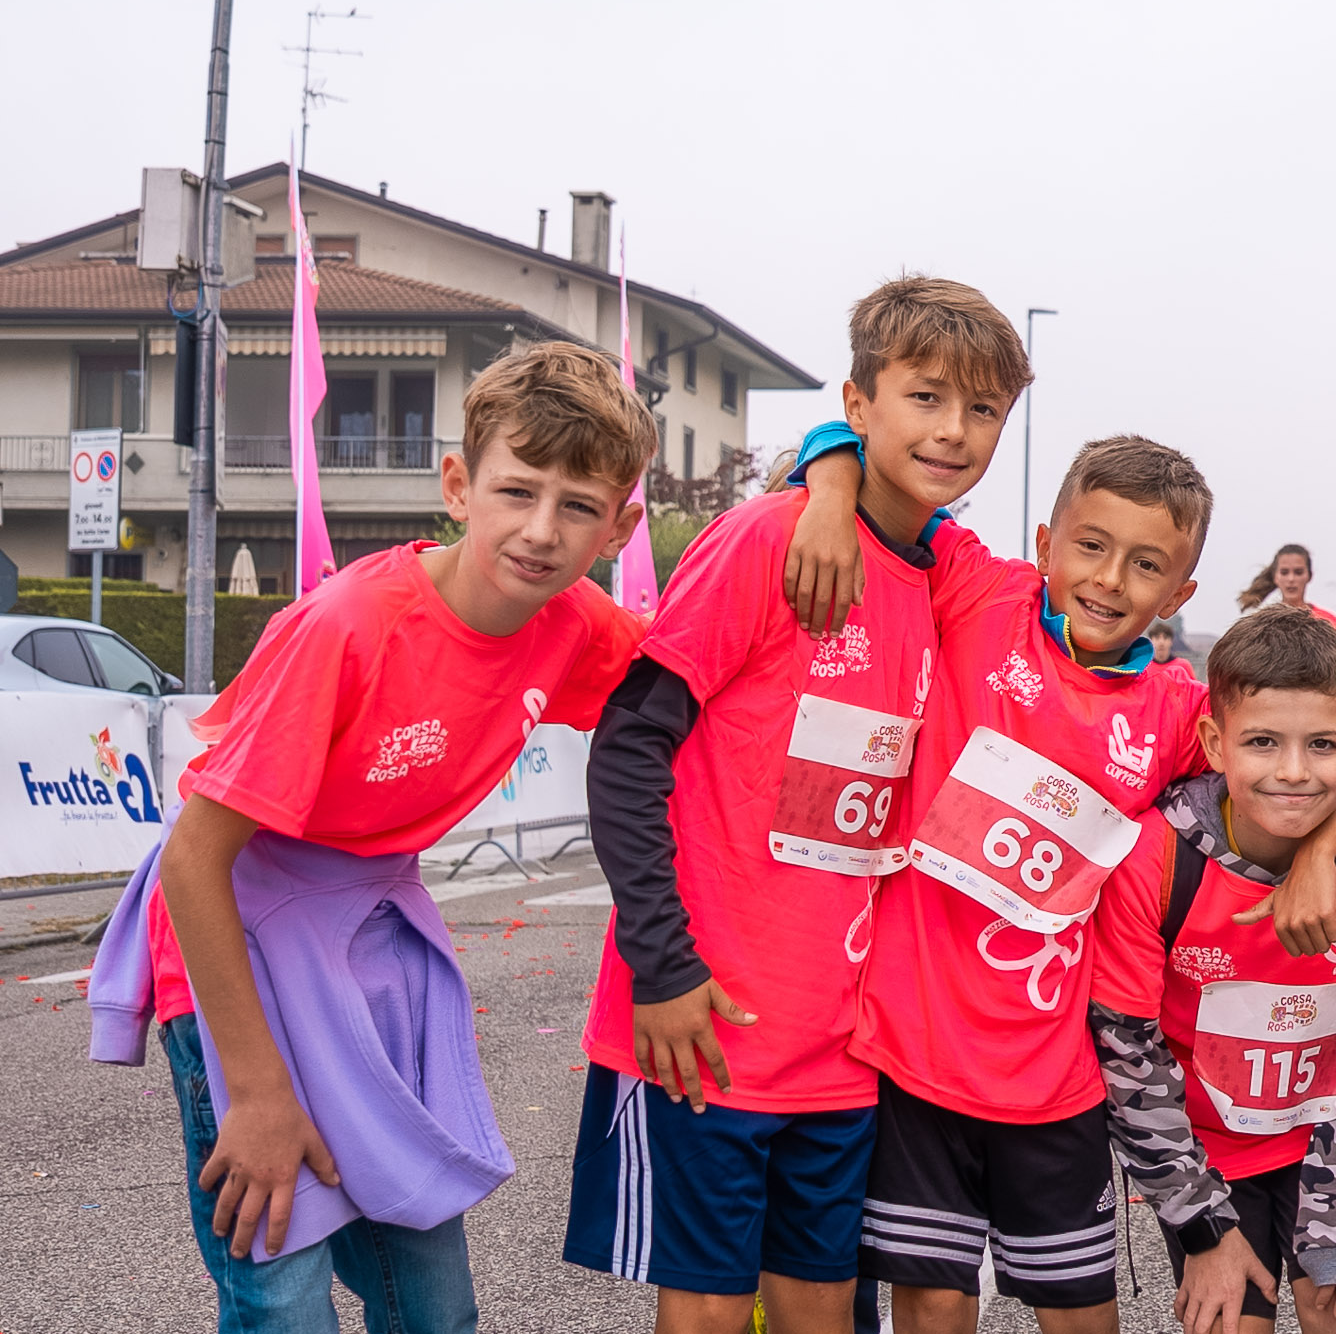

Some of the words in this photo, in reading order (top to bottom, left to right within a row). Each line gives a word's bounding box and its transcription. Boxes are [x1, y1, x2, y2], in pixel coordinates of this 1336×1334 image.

[810, 660, 845, 677] ROSA
[393, 719, 441, 742] CORSA
[522, 746, 552, 774] MGR
[862, 750, 886, 763] ROSA
[18, 762, 113, 805] Frutta
[366, 763, 409, 783] ROSA
[1046, 775, 1078, 797] CORSA
[833, 780, 892, 839] 69
[1023, 792, 1050, 811] ROSA
[982, 816, 1064, 894] 68
[1178, 946, 1222, 958] CORSA
[1280, 994, 1312, 1006] CORSA
[1267, 1021, 1294, 1032] ROSA
[1243, 1045, 1322, 1099] 115
